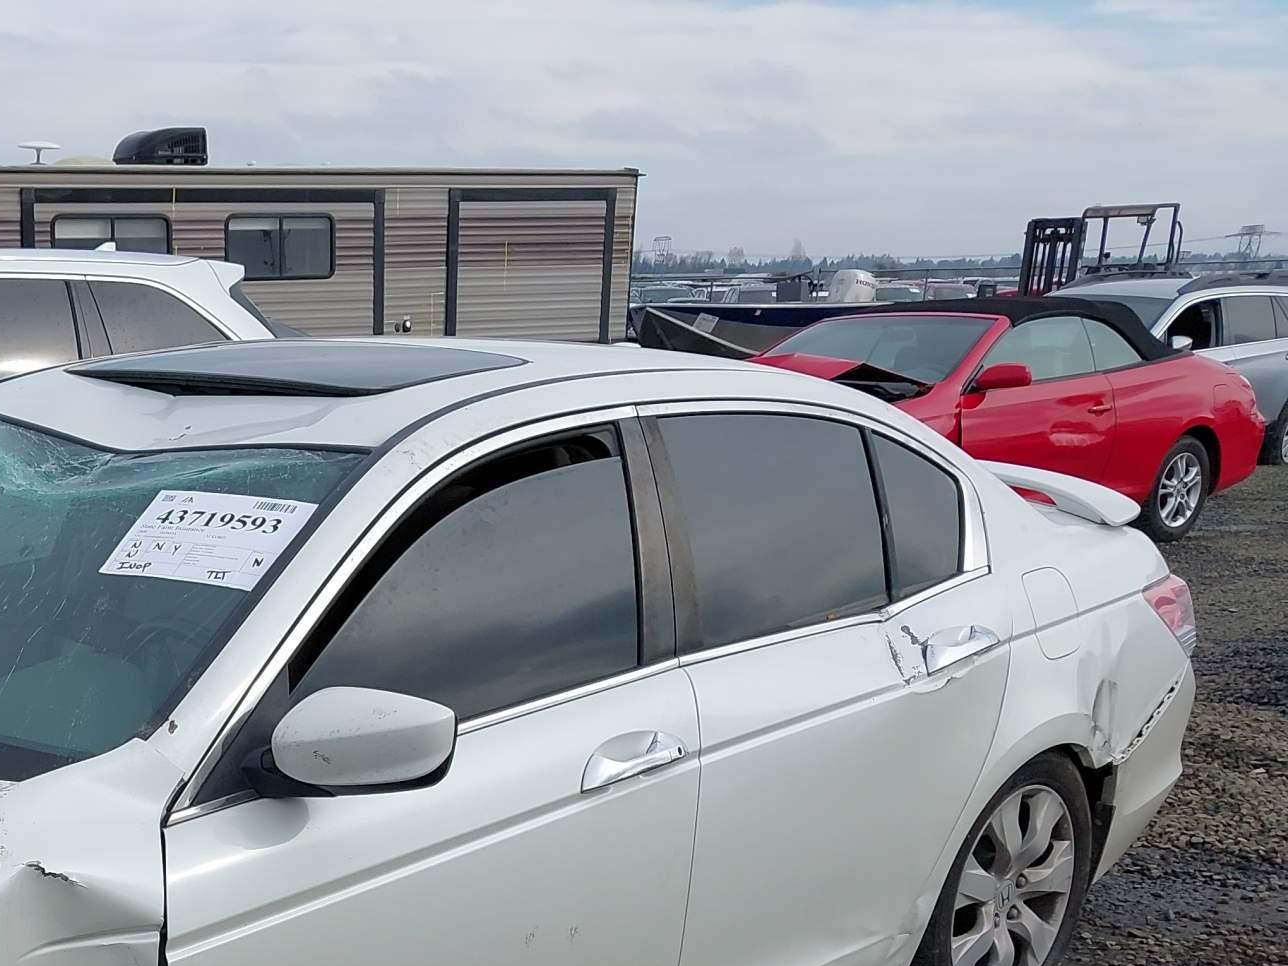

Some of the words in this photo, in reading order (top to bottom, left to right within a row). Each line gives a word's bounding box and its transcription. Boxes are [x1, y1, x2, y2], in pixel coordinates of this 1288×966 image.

[156, 508, 283, 535] 43719593
[153, 541, 166, 551] N
[172, 544, 182, 555] Y
[252, 557, 264, 568] N
